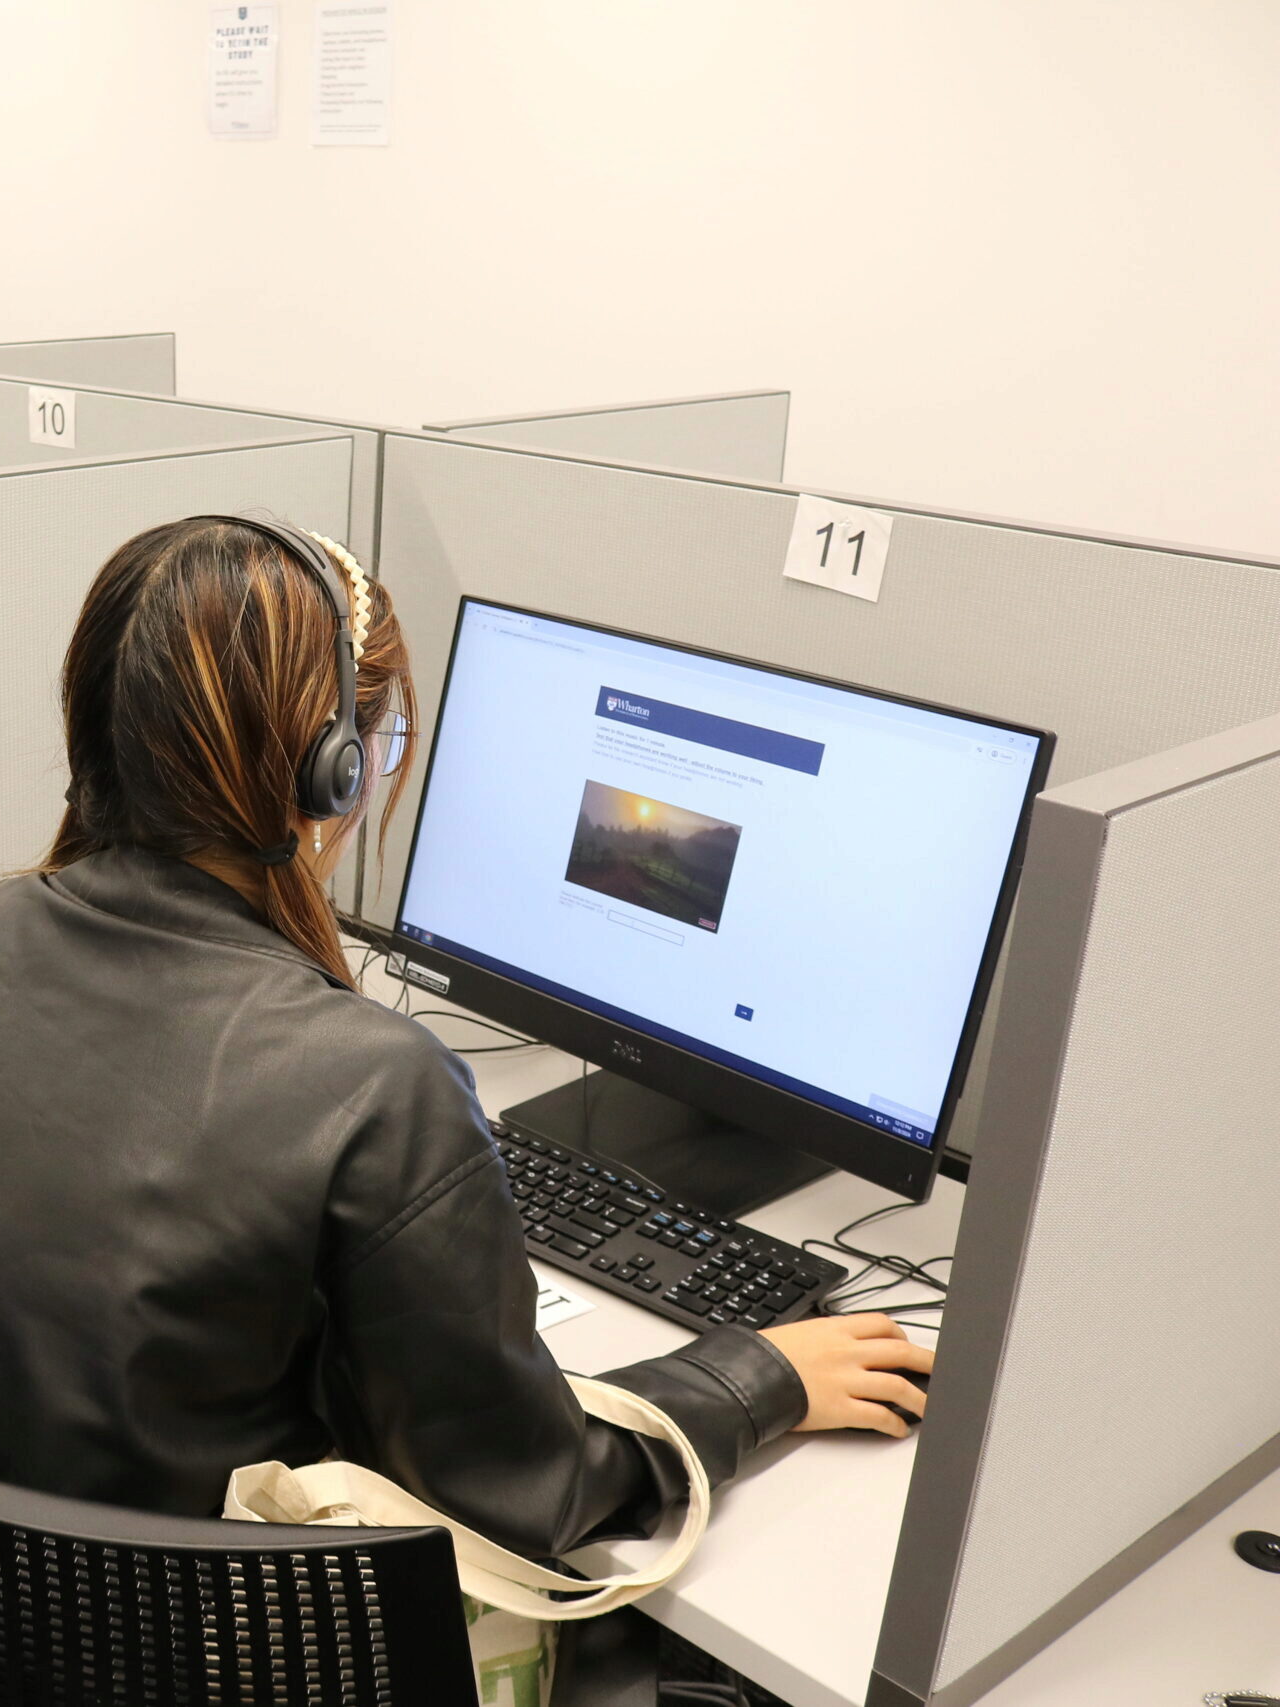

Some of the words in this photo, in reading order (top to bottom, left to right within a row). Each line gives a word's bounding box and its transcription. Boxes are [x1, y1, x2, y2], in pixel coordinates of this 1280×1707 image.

[216, 27, 245, 37] PLEASE
[249, 25, 269, 34] WAIT
[228, 51, 253, 60] STUDY
[38, 401, 65, 436] 10
[816, 521, 865, 576] 11
[617, 698, 650, 717] Wharton
